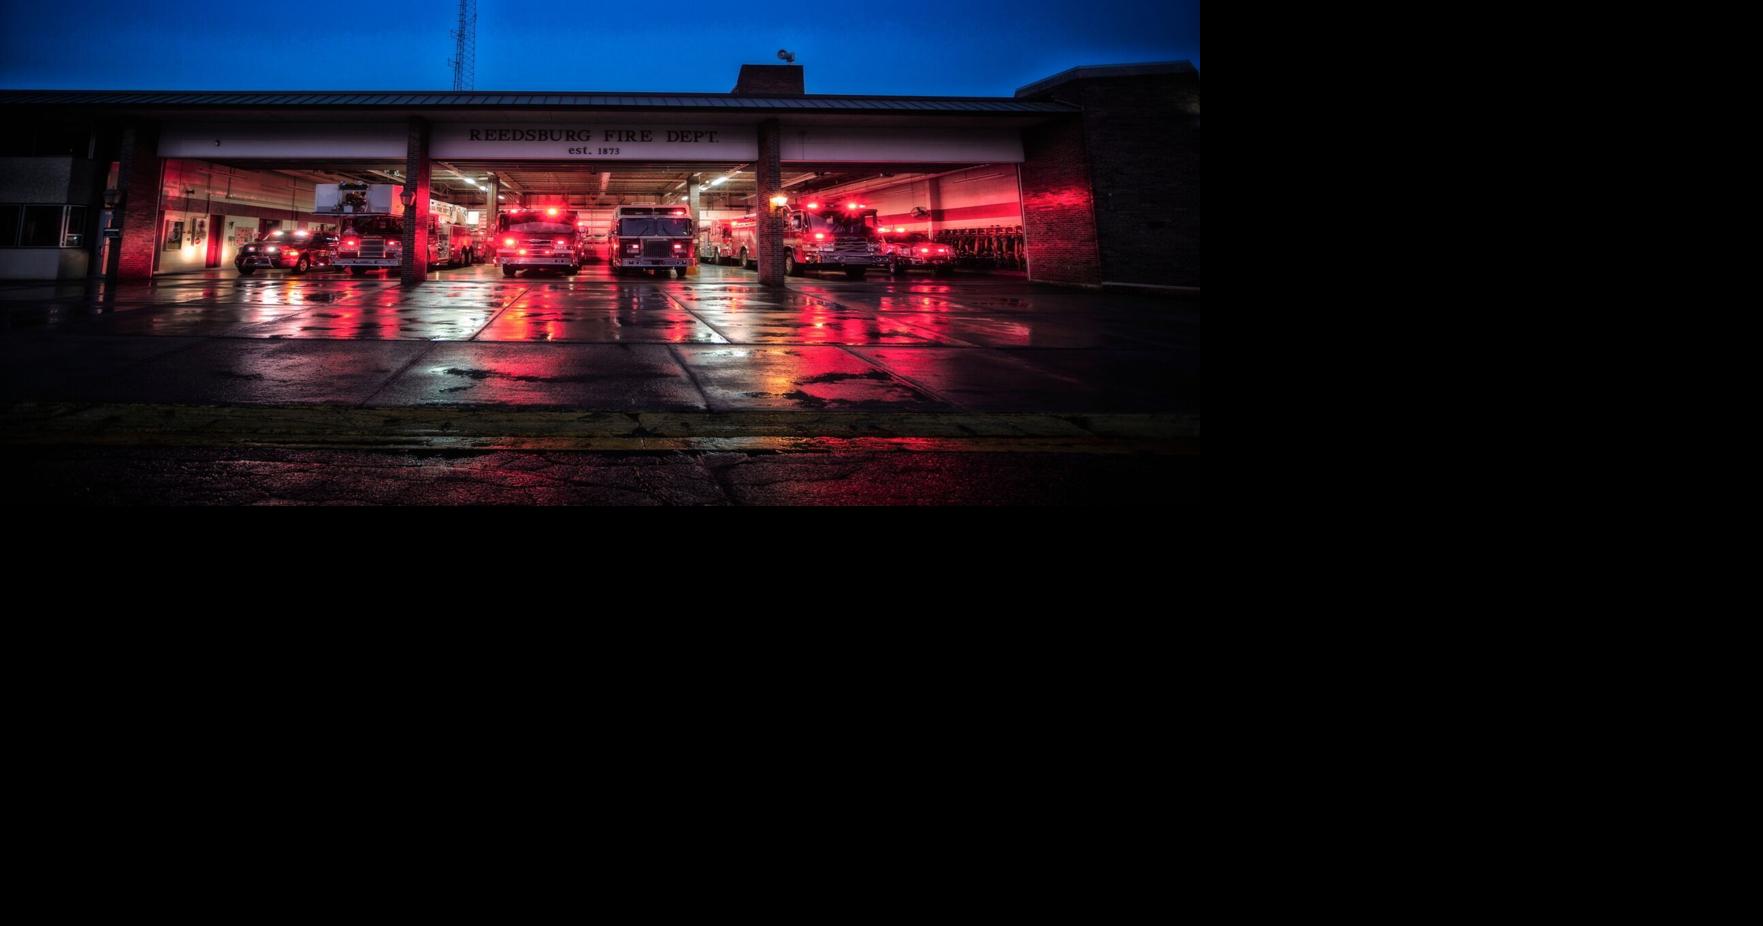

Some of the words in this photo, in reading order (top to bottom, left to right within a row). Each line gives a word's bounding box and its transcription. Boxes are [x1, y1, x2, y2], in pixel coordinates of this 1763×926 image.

[469, 128, 592, 142] REEDSBURG
[604, 129, 654, 143] FIRE
[666, 129, 720, 143] DEPT.
[568, 146, 592, 155] est.
[598, 147, 620, 155] 1873
